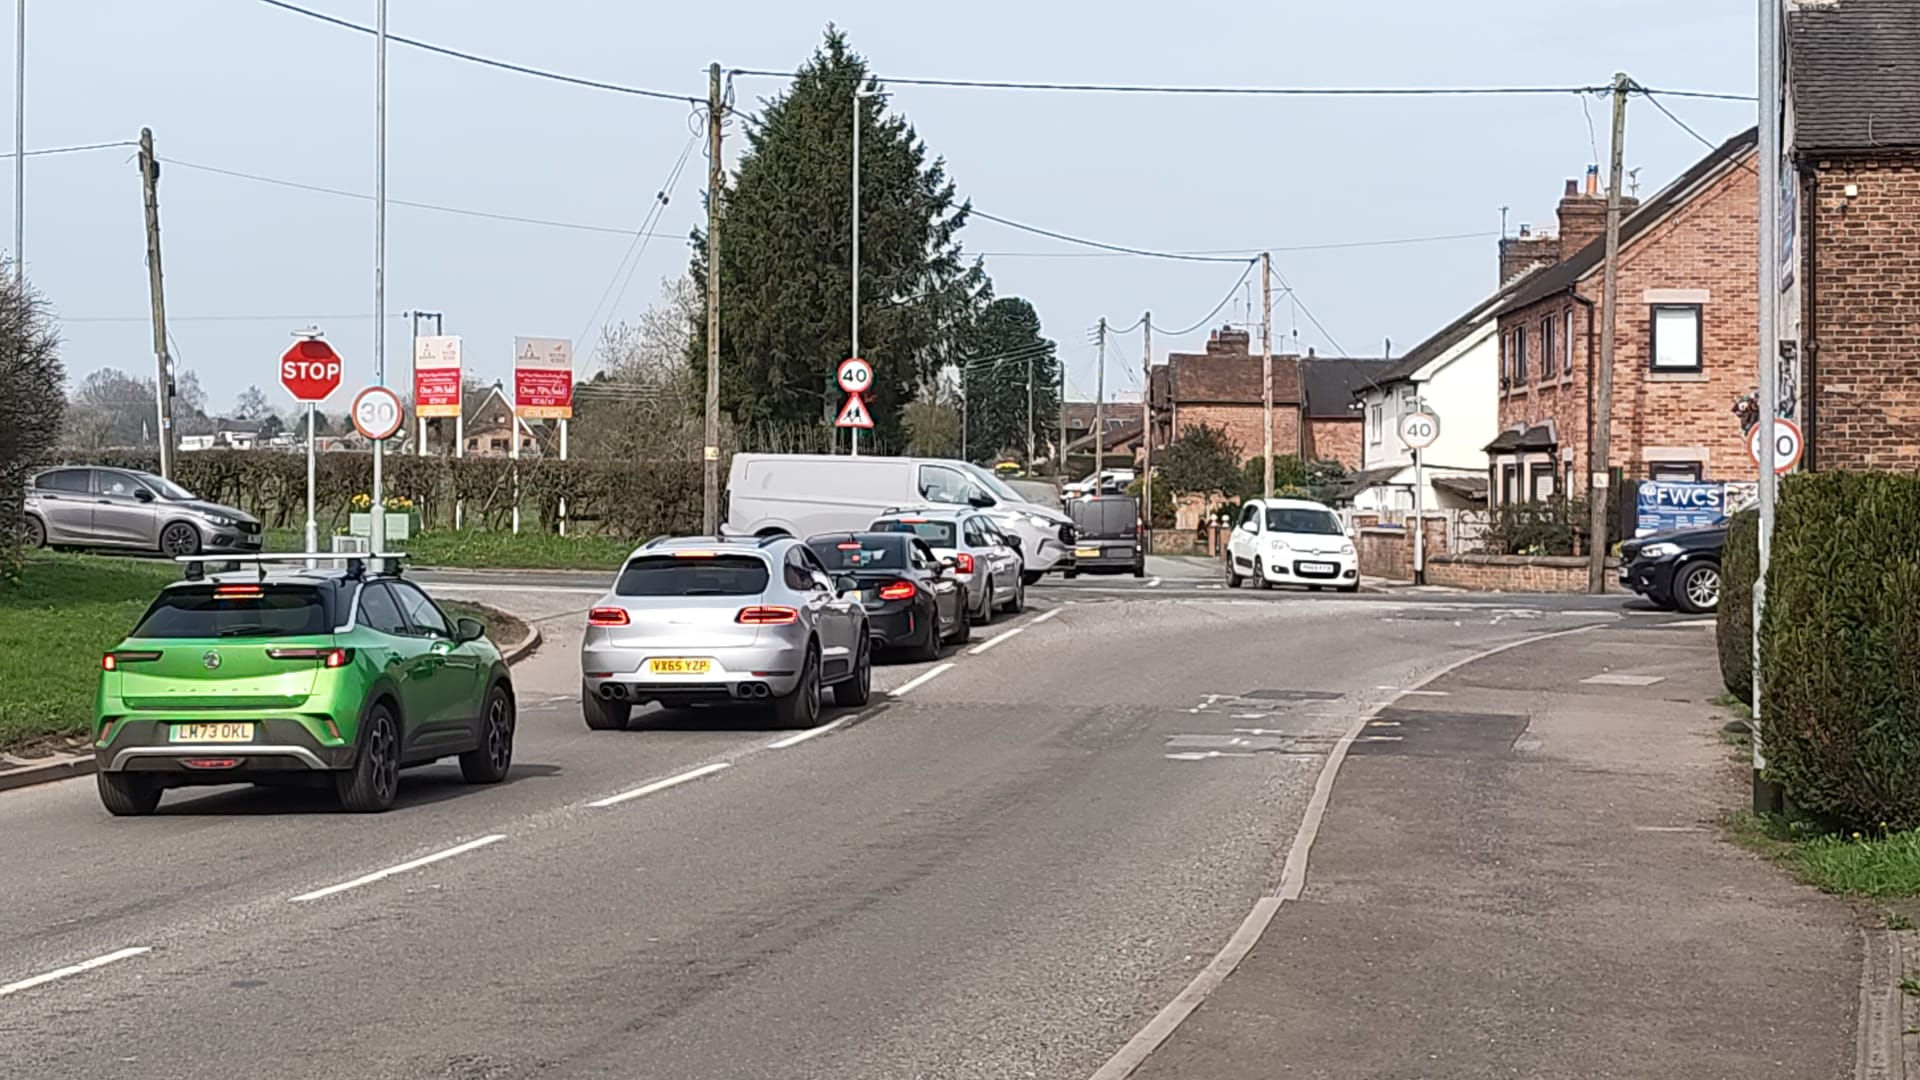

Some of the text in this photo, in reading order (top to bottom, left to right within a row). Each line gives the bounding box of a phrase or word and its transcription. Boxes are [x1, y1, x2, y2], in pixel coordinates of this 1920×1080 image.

[283, 361, 340, 380] STOP
[842, 369, 867, 382] 40
[361, 403, 394, 423] 30
[1407, 423, 1431, 437] 40
[1657, 488, 1719, 506] FWCS
[653, 660, 706, 671] VX65 YZP
[221, 724, 250, 739] OKL
